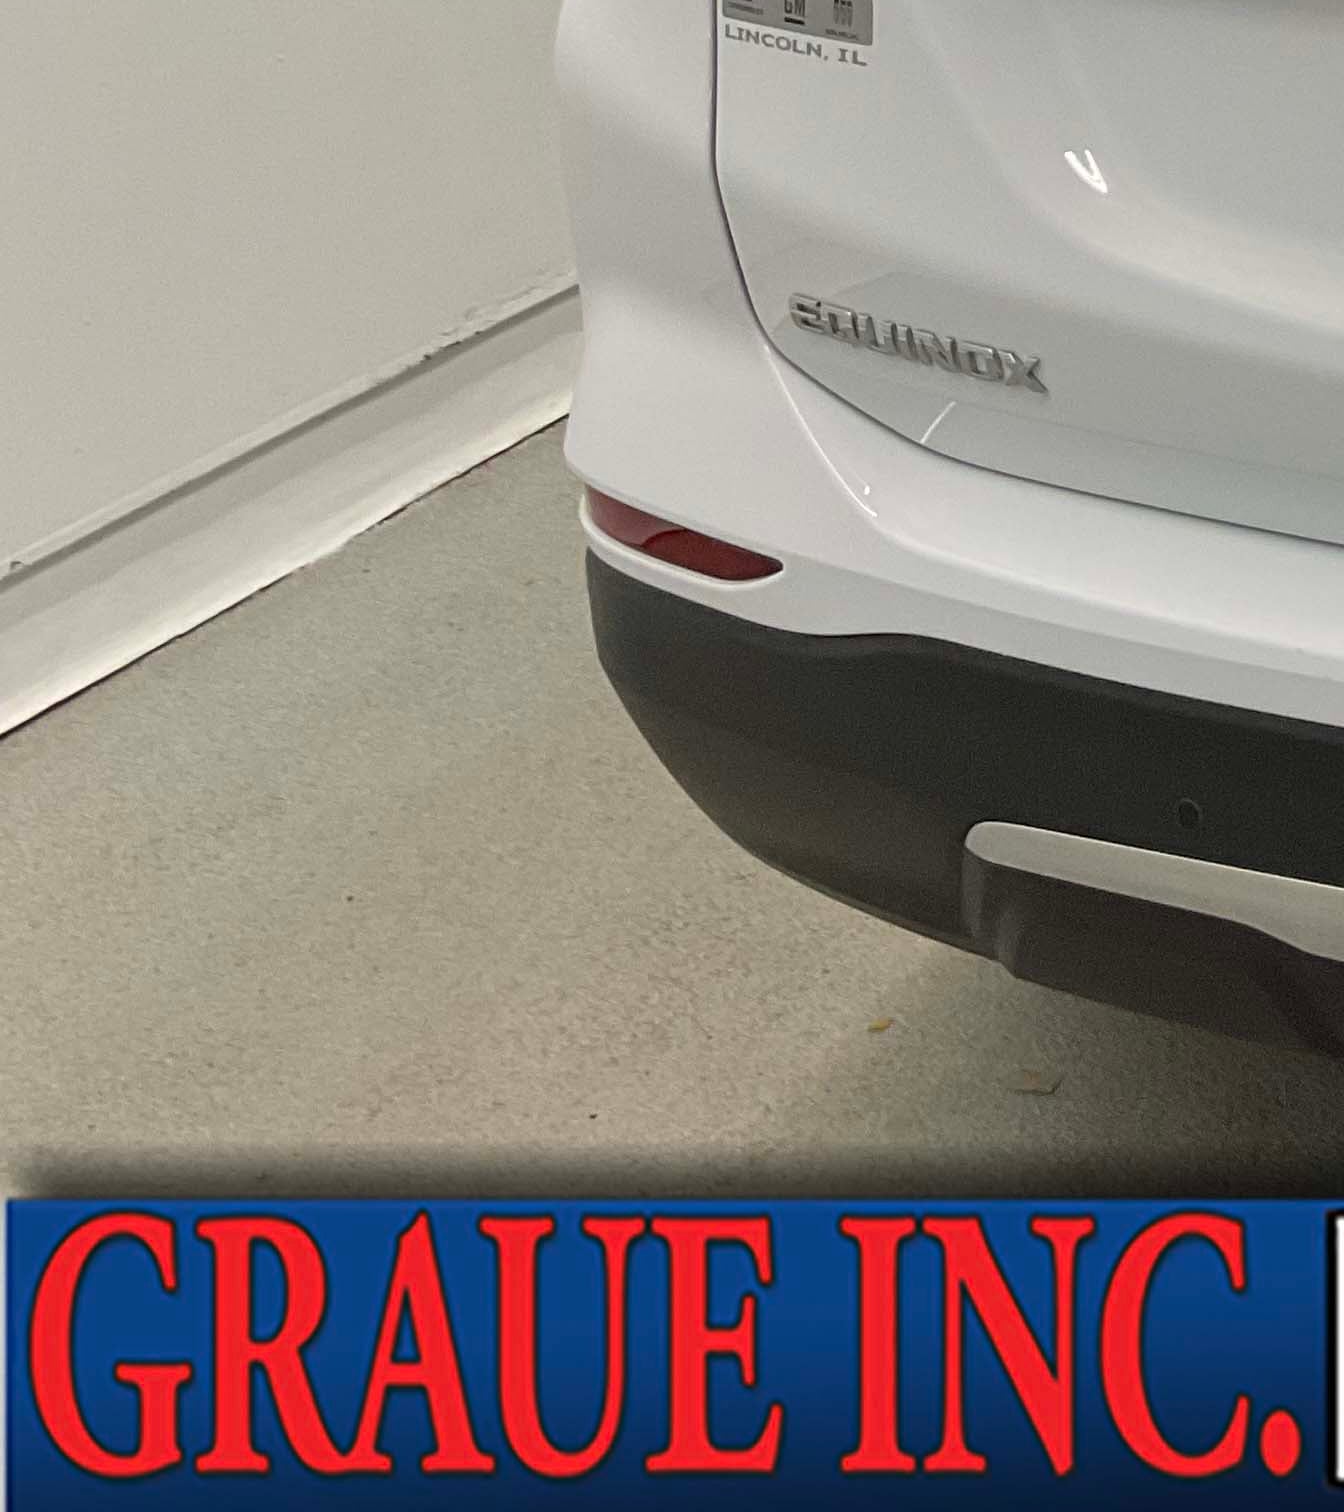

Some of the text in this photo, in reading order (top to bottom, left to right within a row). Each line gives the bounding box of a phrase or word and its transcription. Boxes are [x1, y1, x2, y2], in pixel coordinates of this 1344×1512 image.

[724, 24, 829, 61] LINCOLN,
[838, 48, 868, 67] IL
[789, 292, 1048, 393] EQUINOX
